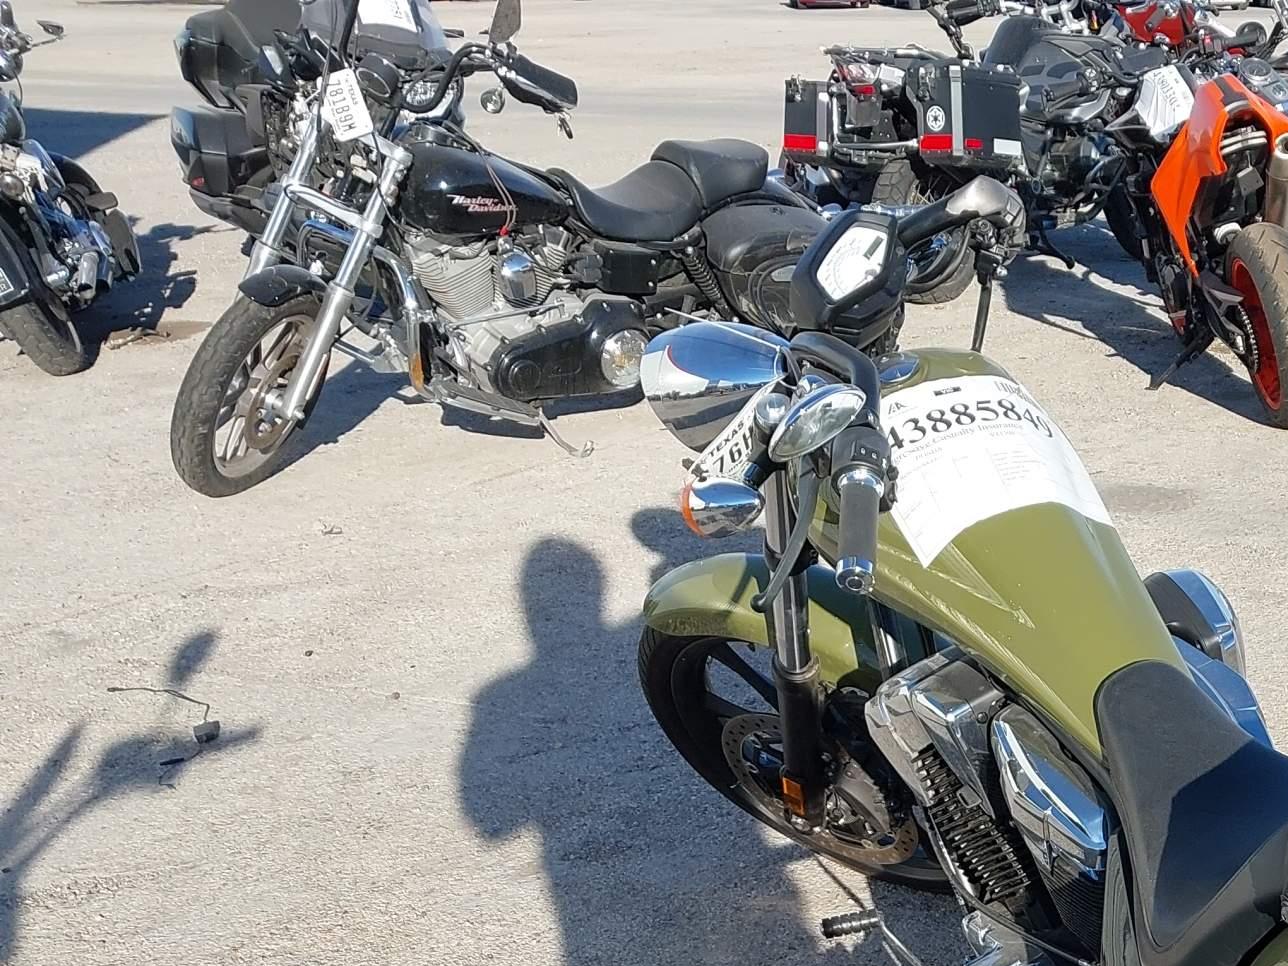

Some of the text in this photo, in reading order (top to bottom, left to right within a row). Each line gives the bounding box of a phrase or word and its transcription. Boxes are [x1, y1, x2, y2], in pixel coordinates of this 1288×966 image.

[348, 84, 359, 105] TEXAS
[708, 420, 744, 457] TEXAS
[887, 398, 1053, 450] 43885849
